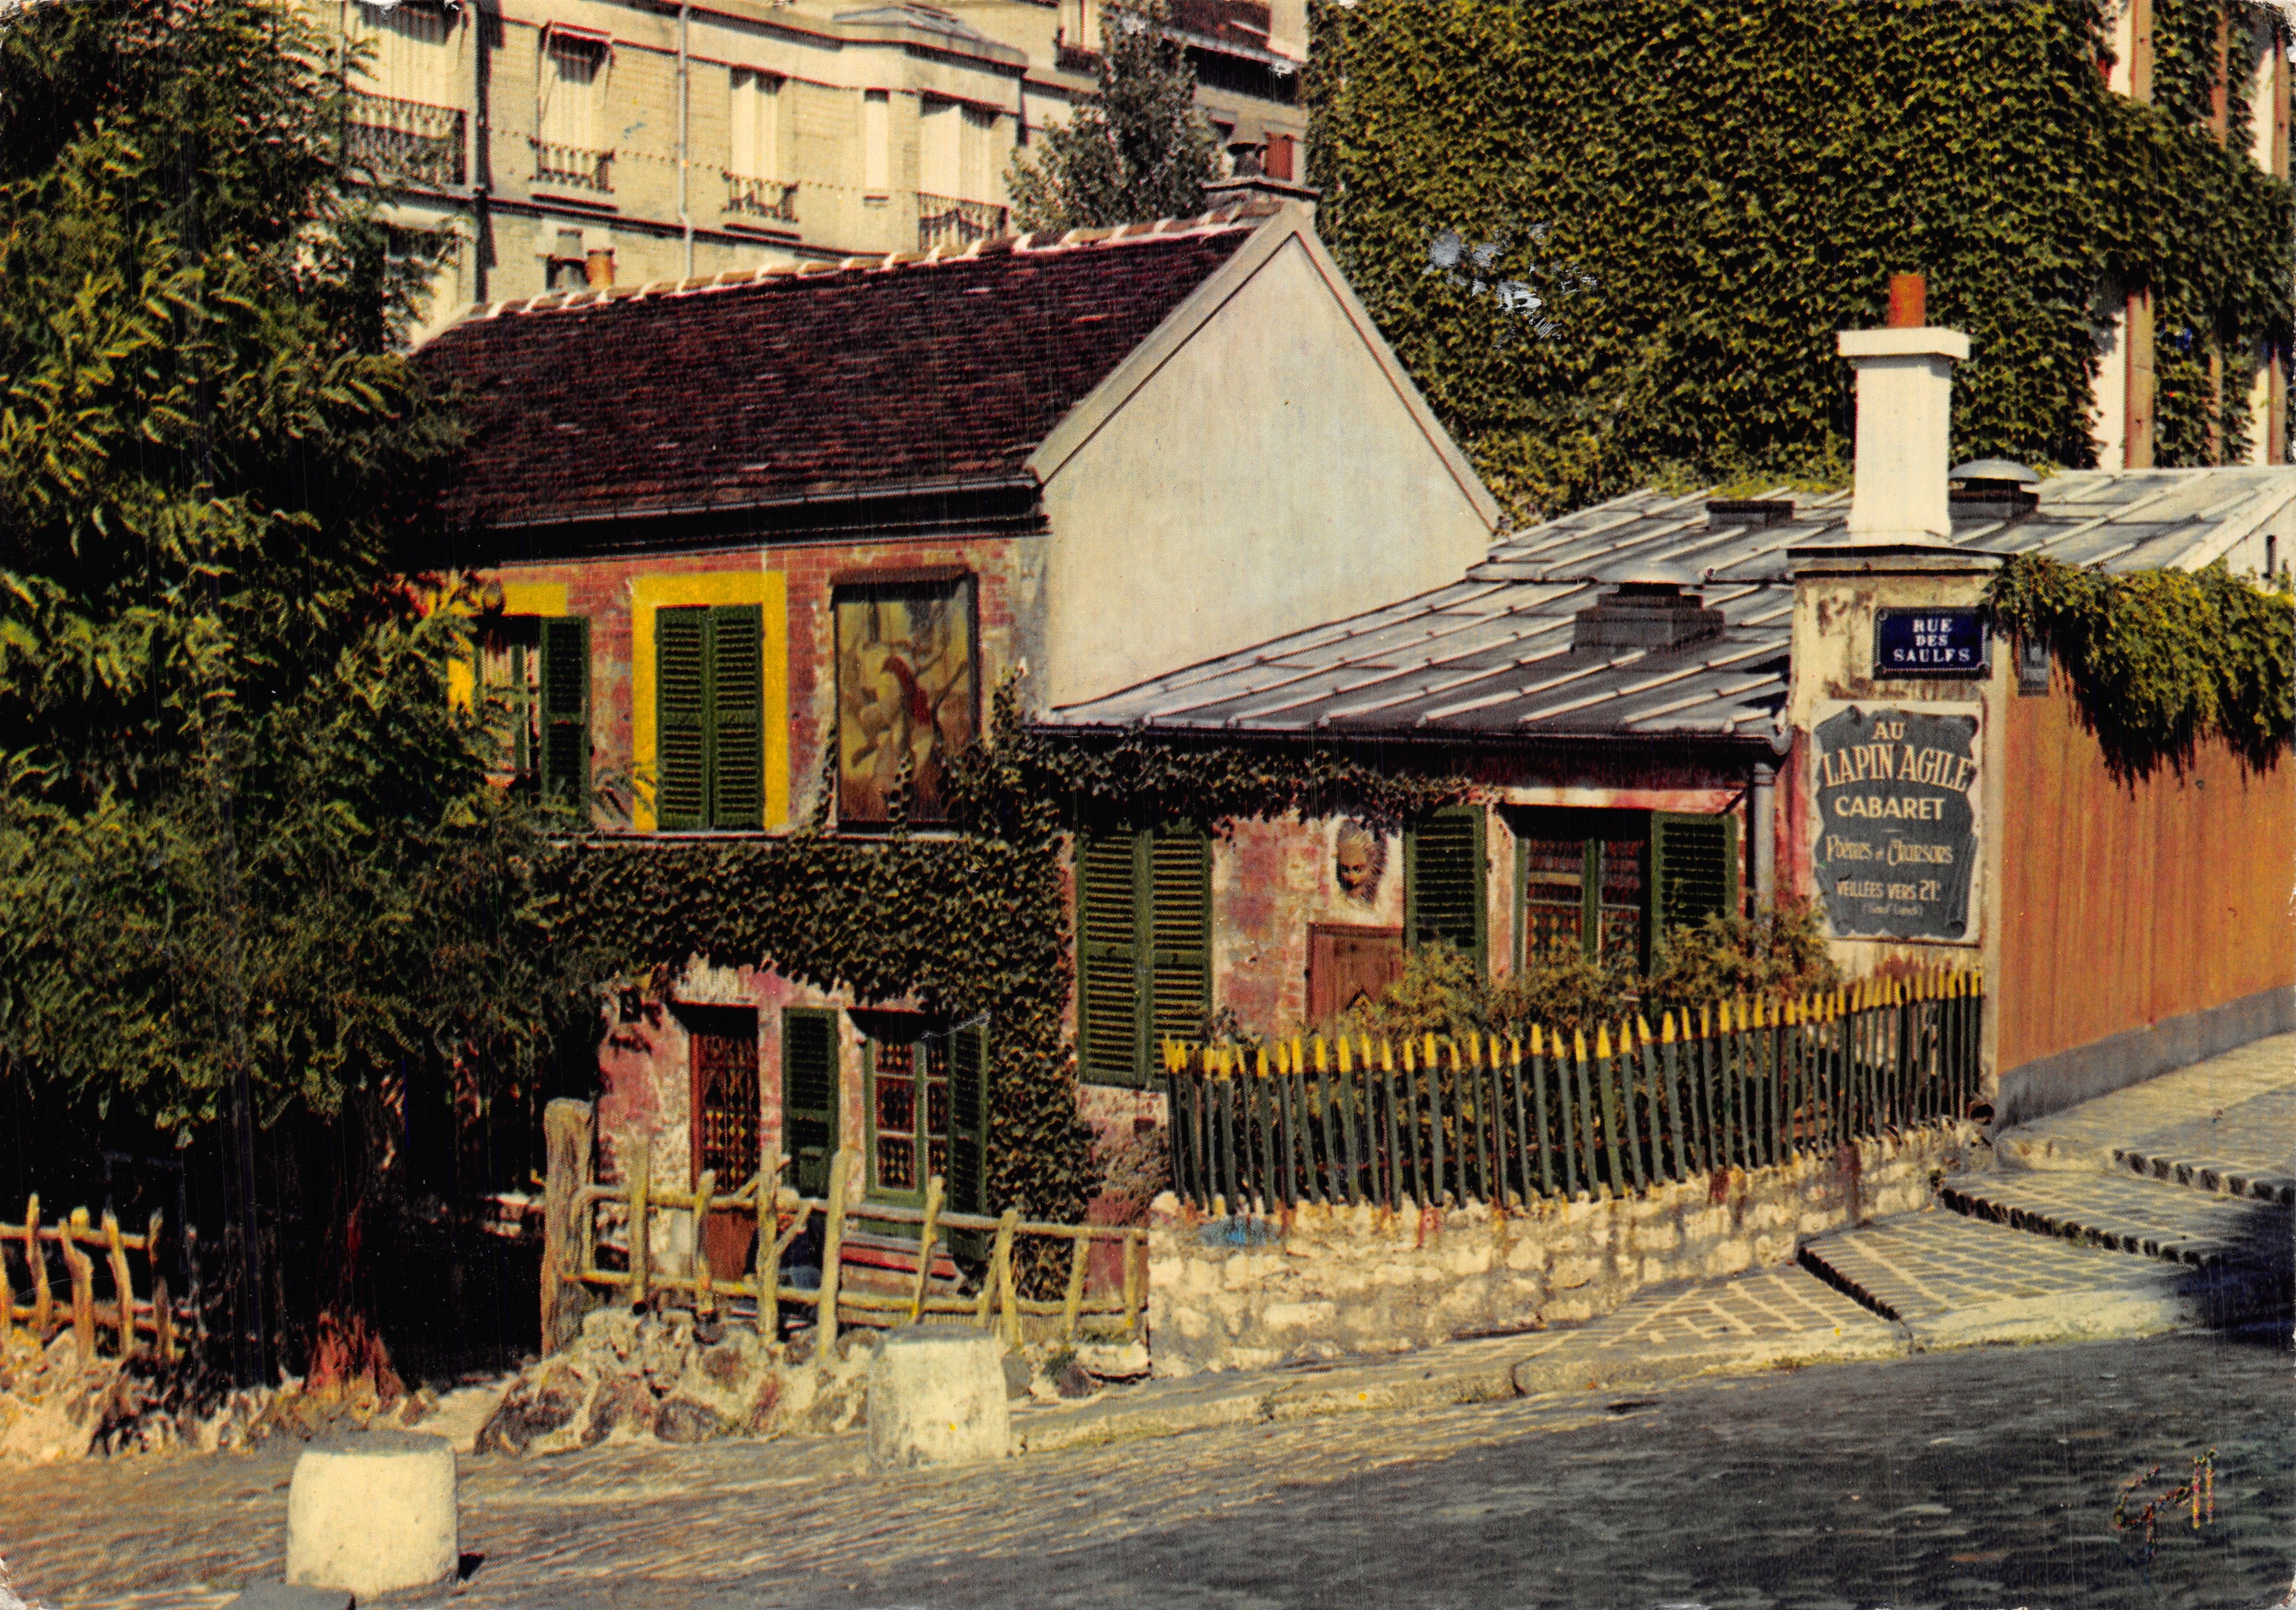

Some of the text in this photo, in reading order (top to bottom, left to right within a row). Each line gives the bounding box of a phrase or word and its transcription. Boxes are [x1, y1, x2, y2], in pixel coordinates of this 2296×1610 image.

[1912, 618, 1953, 633] RUE
[1915, 634, 1949, 647] DES
[1893, 648, 1971, 663] SAULES
[1872, 722, 1906, 740] AU
[1822, 744, 1974, 792] LAPIN AGILE
[1834, 796, 1946, 821] CABARET
